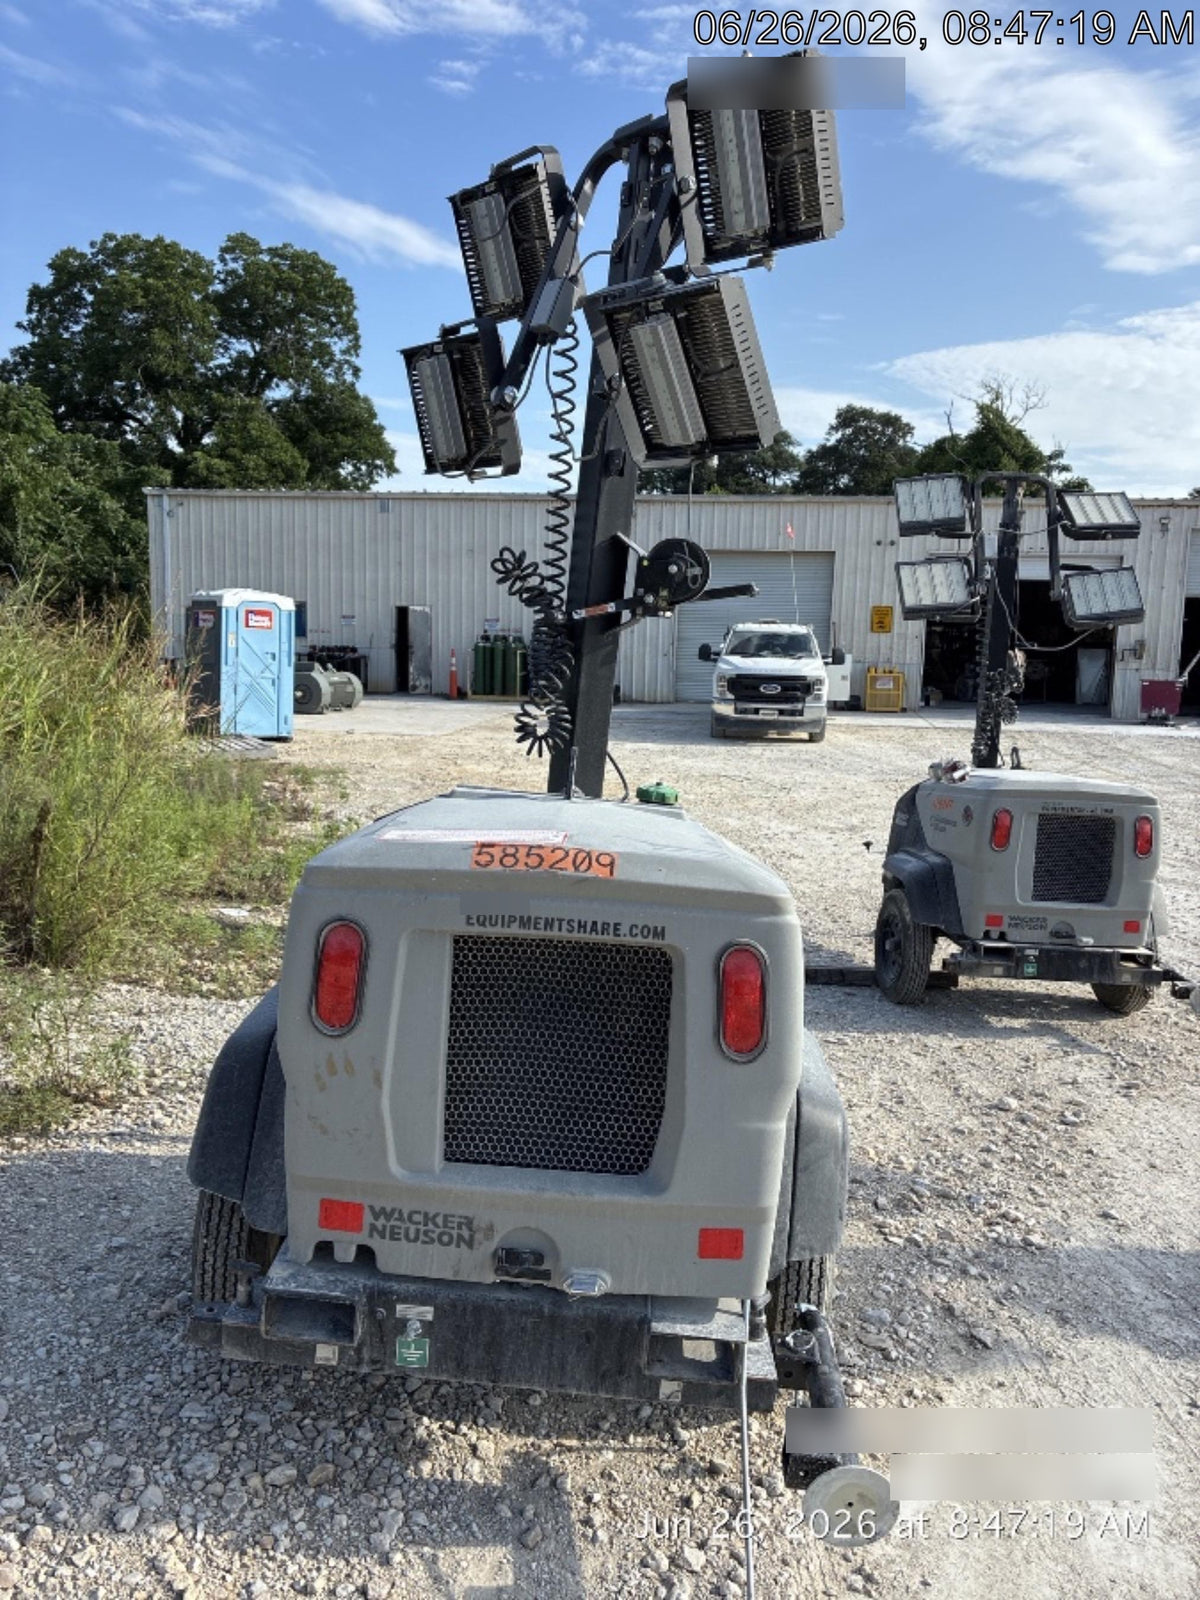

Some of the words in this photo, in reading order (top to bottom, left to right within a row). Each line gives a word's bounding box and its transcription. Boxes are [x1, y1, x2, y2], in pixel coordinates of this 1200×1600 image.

[474, 845, 615, 876] 585209
[465, 914, 666, 941] EQUIPMENTSHARE.COM
[368, 1205, 475, 1233] WACKER
[368, 1223, 474, 1250] NEUSON
